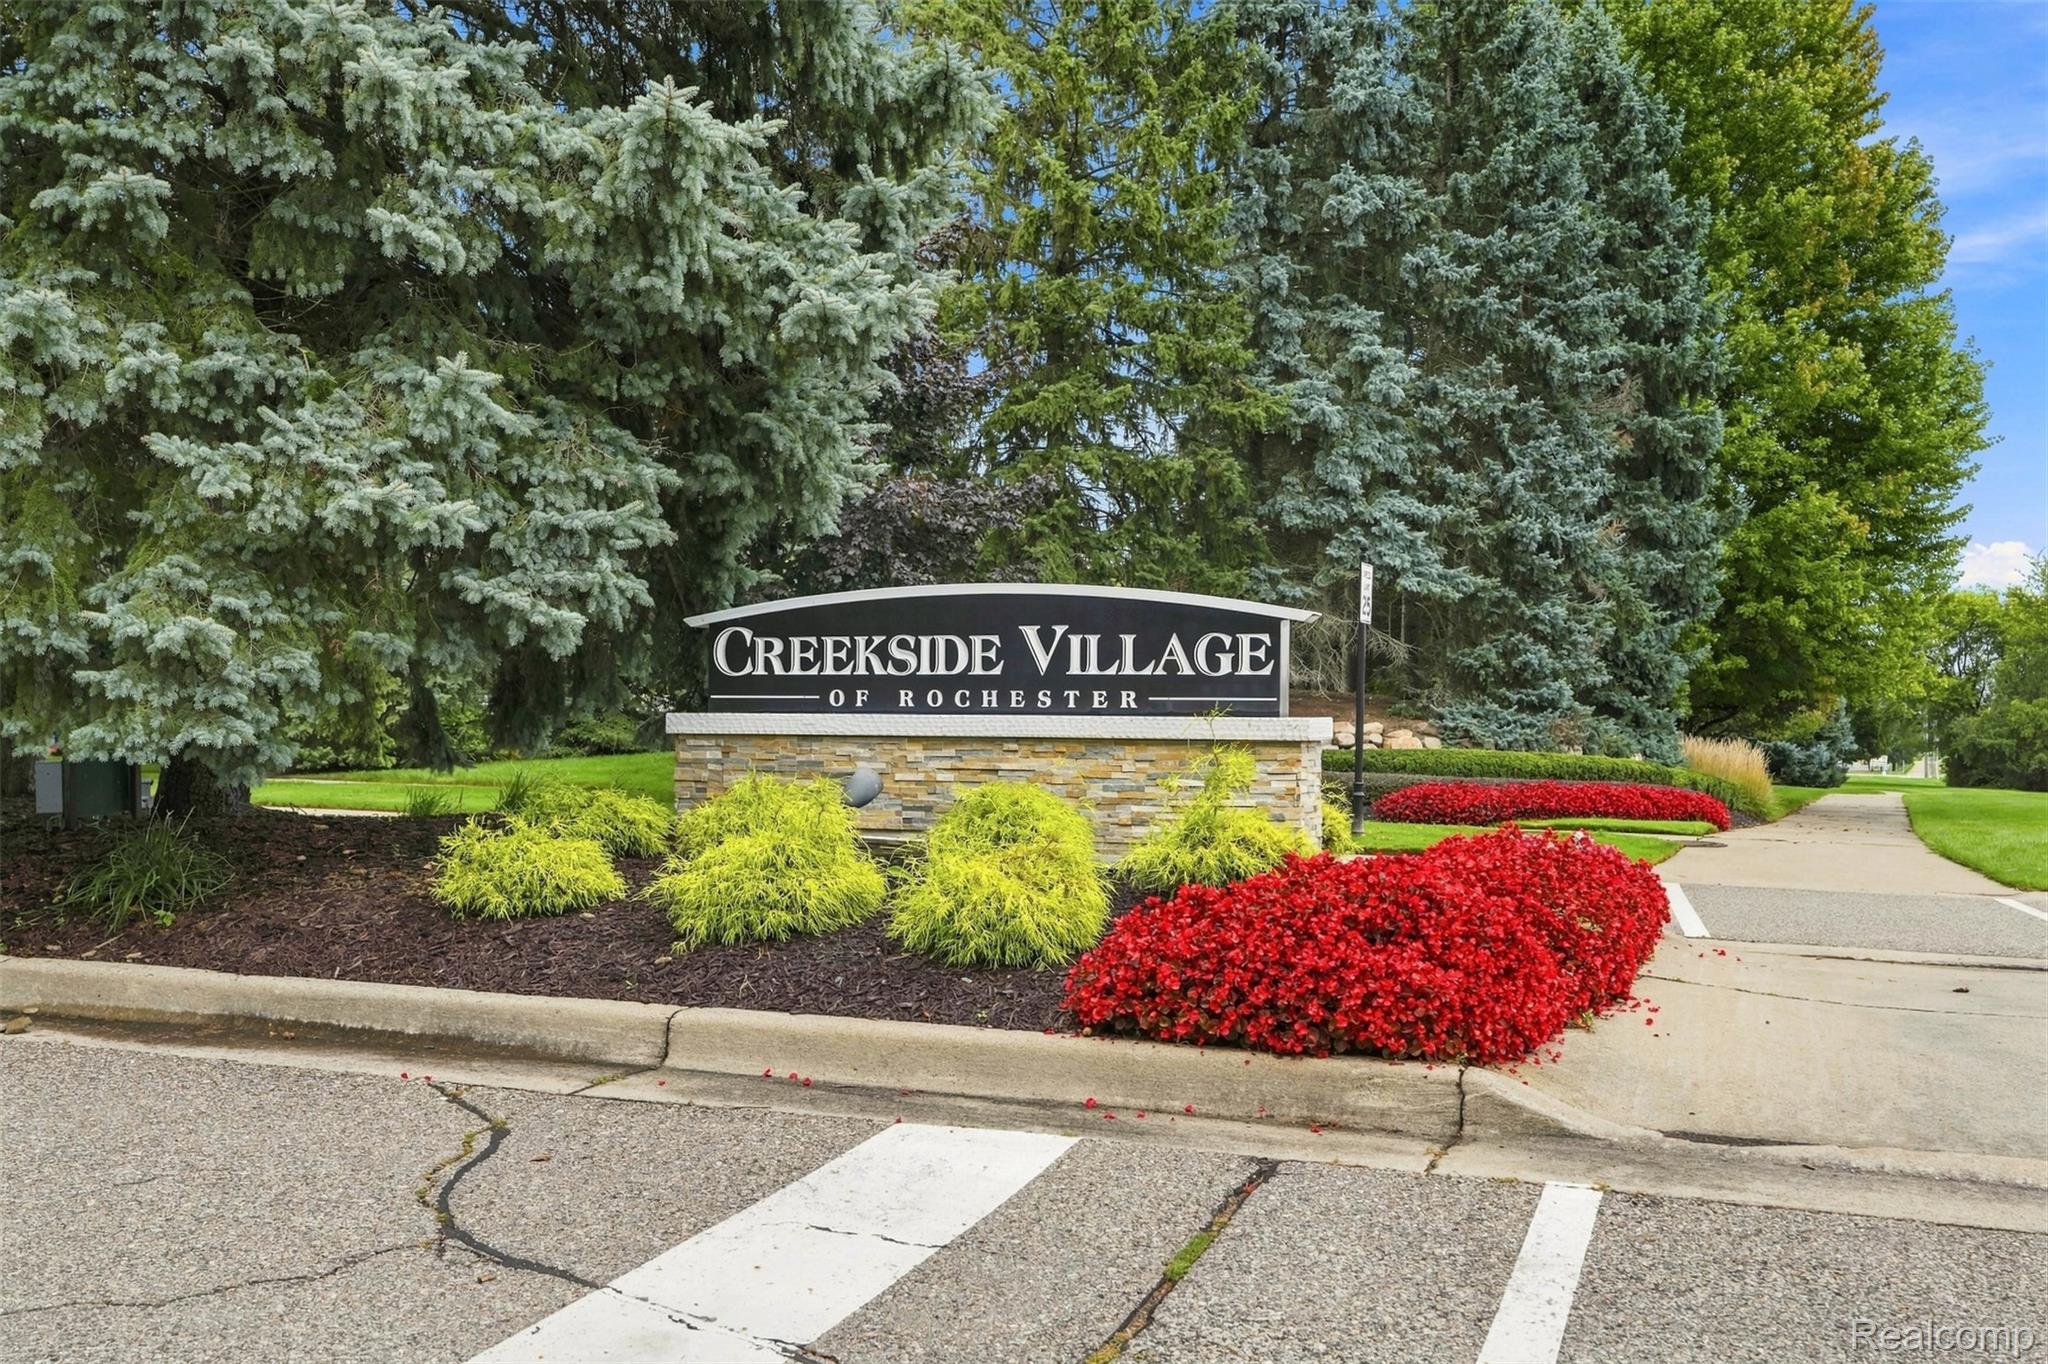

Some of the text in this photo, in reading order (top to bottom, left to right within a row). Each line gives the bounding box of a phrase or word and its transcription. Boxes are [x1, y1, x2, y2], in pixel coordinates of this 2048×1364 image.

[713, 624, 1275, 676] CREEKSIDE VILLAGE
[829, 689, 1139, 709] OF ROCHESTER
